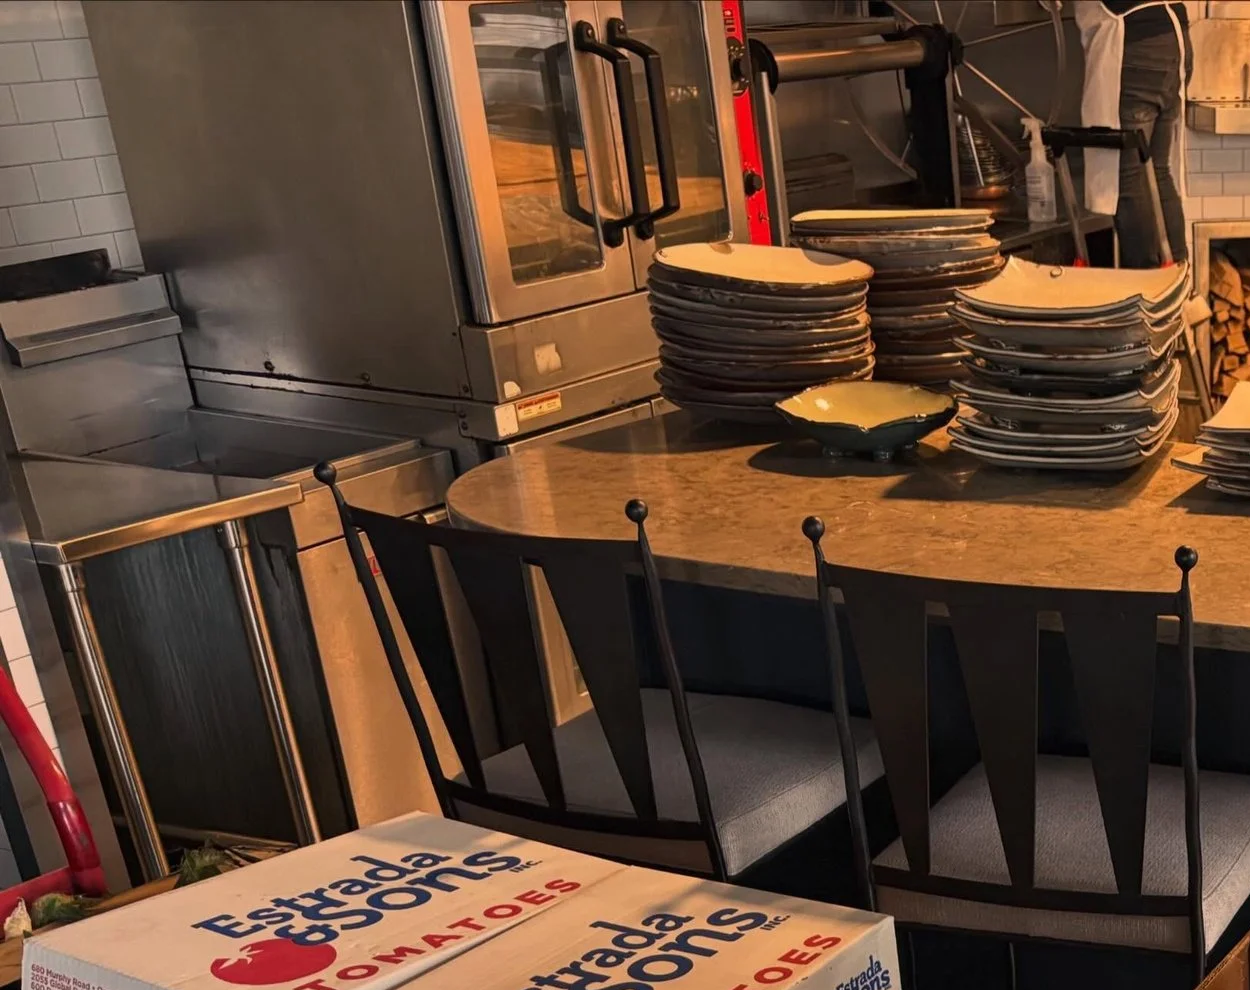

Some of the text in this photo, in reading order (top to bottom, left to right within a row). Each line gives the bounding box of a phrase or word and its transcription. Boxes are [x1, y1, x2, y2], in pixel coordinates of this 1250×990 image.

[191, 852, 453, 939] Estrada
[31, 963, 44, 974] 680
[46, 968, 71, 985] Murphy
[72, 977, 90, 990] Road
